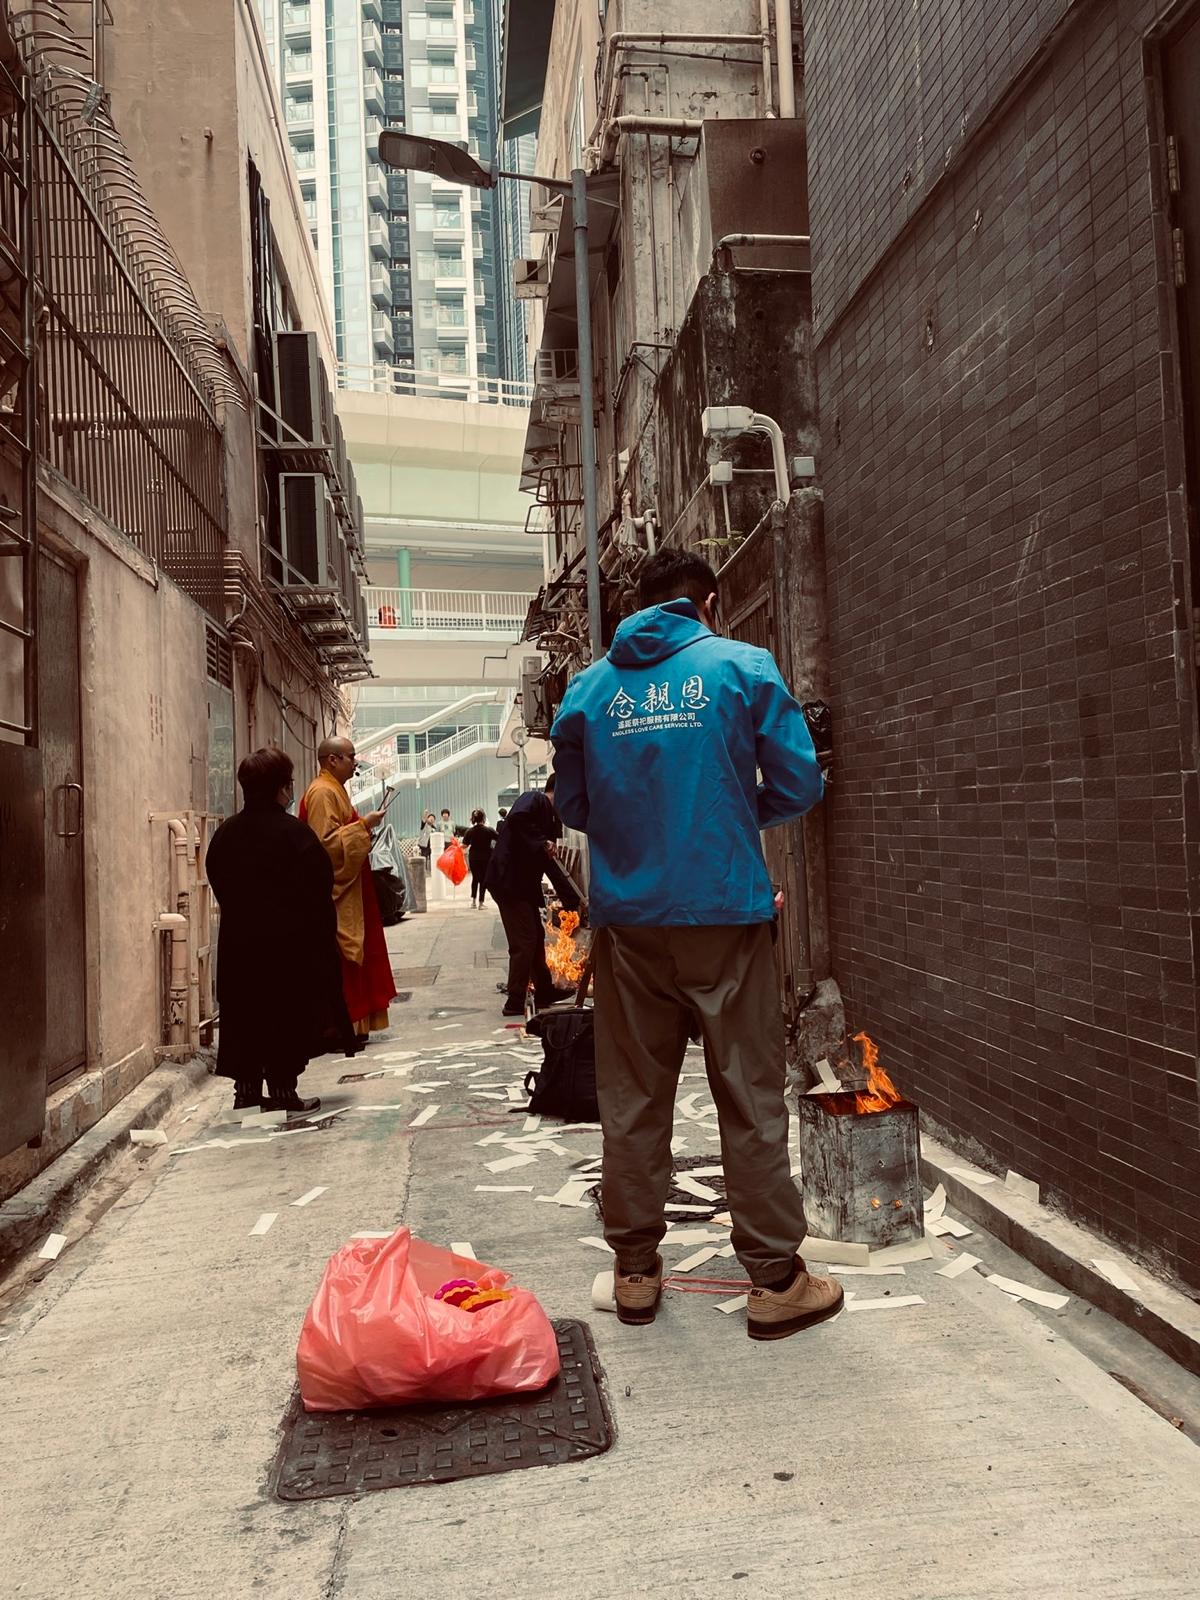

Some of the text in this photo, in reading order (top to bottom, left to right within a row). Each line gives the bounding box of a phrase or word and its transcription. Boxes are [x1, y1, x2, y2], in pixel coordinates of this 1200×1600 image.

[606, 675, 710, 719] 念親恩
[612, 728, 635, 737] ENDLESS
[634, 726, 649, 734] LOVE
[648, 723, 664, 731] CARE
[664, 722, 689, 730] SERVICE
[370, 743, 393, 758] 24
